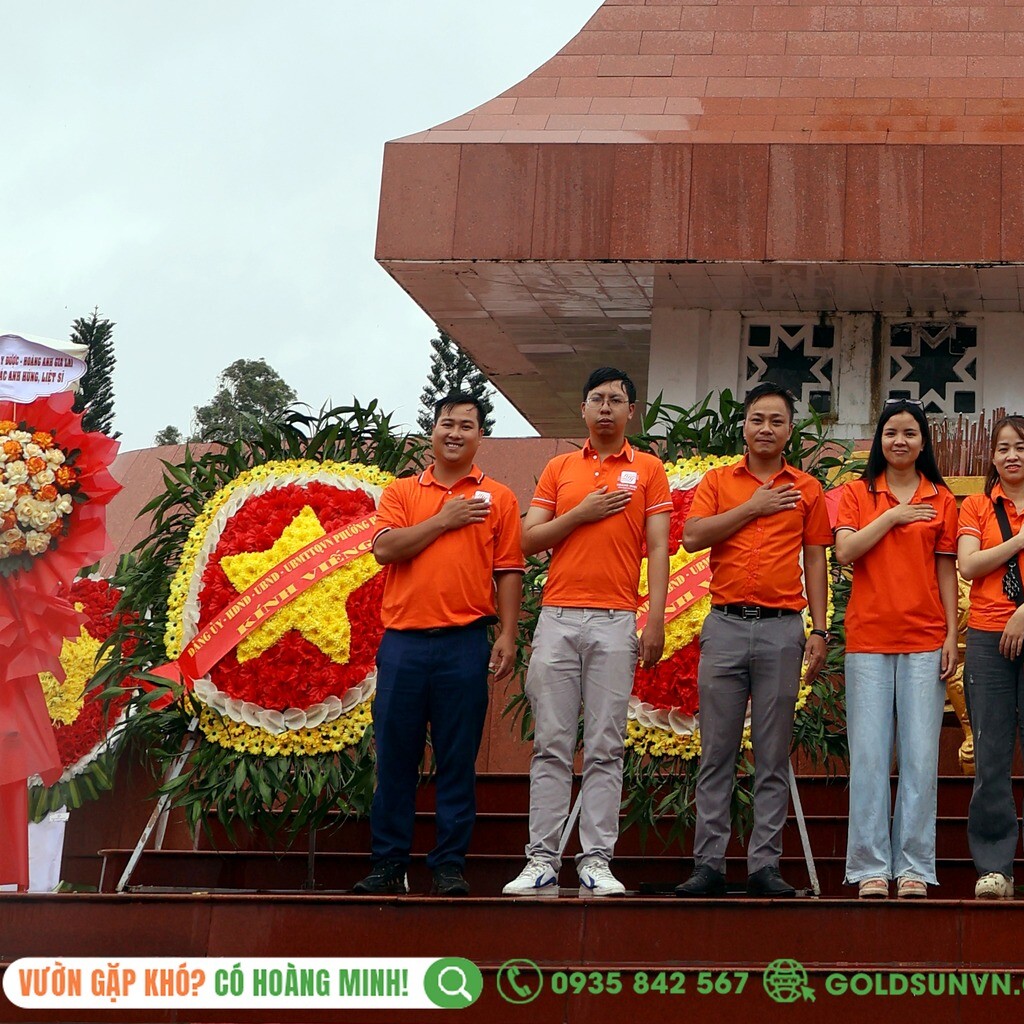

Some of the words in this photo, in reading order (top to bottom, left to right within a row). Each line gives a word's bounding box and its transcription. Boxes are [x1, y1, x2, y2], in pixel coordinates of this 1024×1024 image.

[236, 583, 299, 636] KÍNH
[300, 539, 373, 581] VIẾNG
[253, 572, 280, 596] UBND
